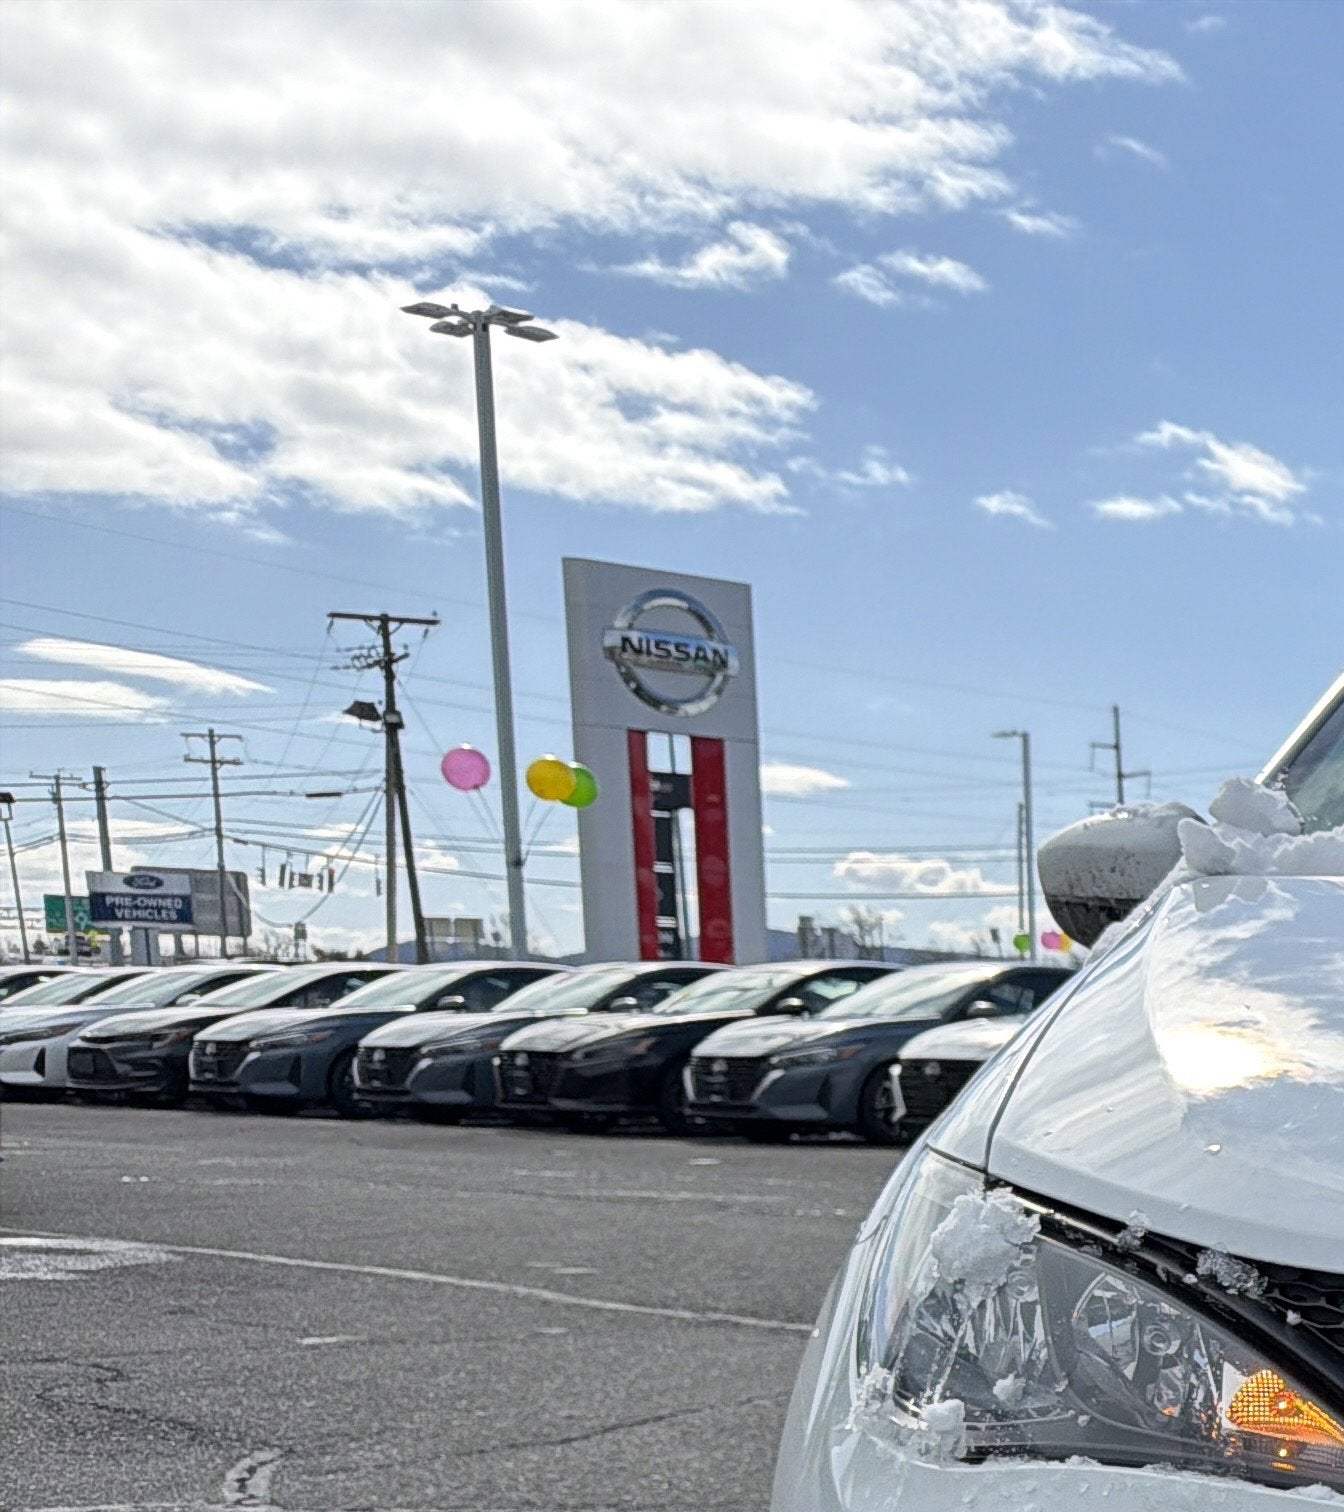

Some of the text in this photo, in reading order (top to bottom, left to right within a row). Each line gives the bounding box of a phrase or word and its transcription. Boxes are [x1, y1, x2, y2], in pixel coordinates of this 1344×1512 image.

[621, 634, 729, 669] NISSAN
[105, 895, 183, 909] PRE-OWNED
[114, 908, 178, 921] VEHICLES
